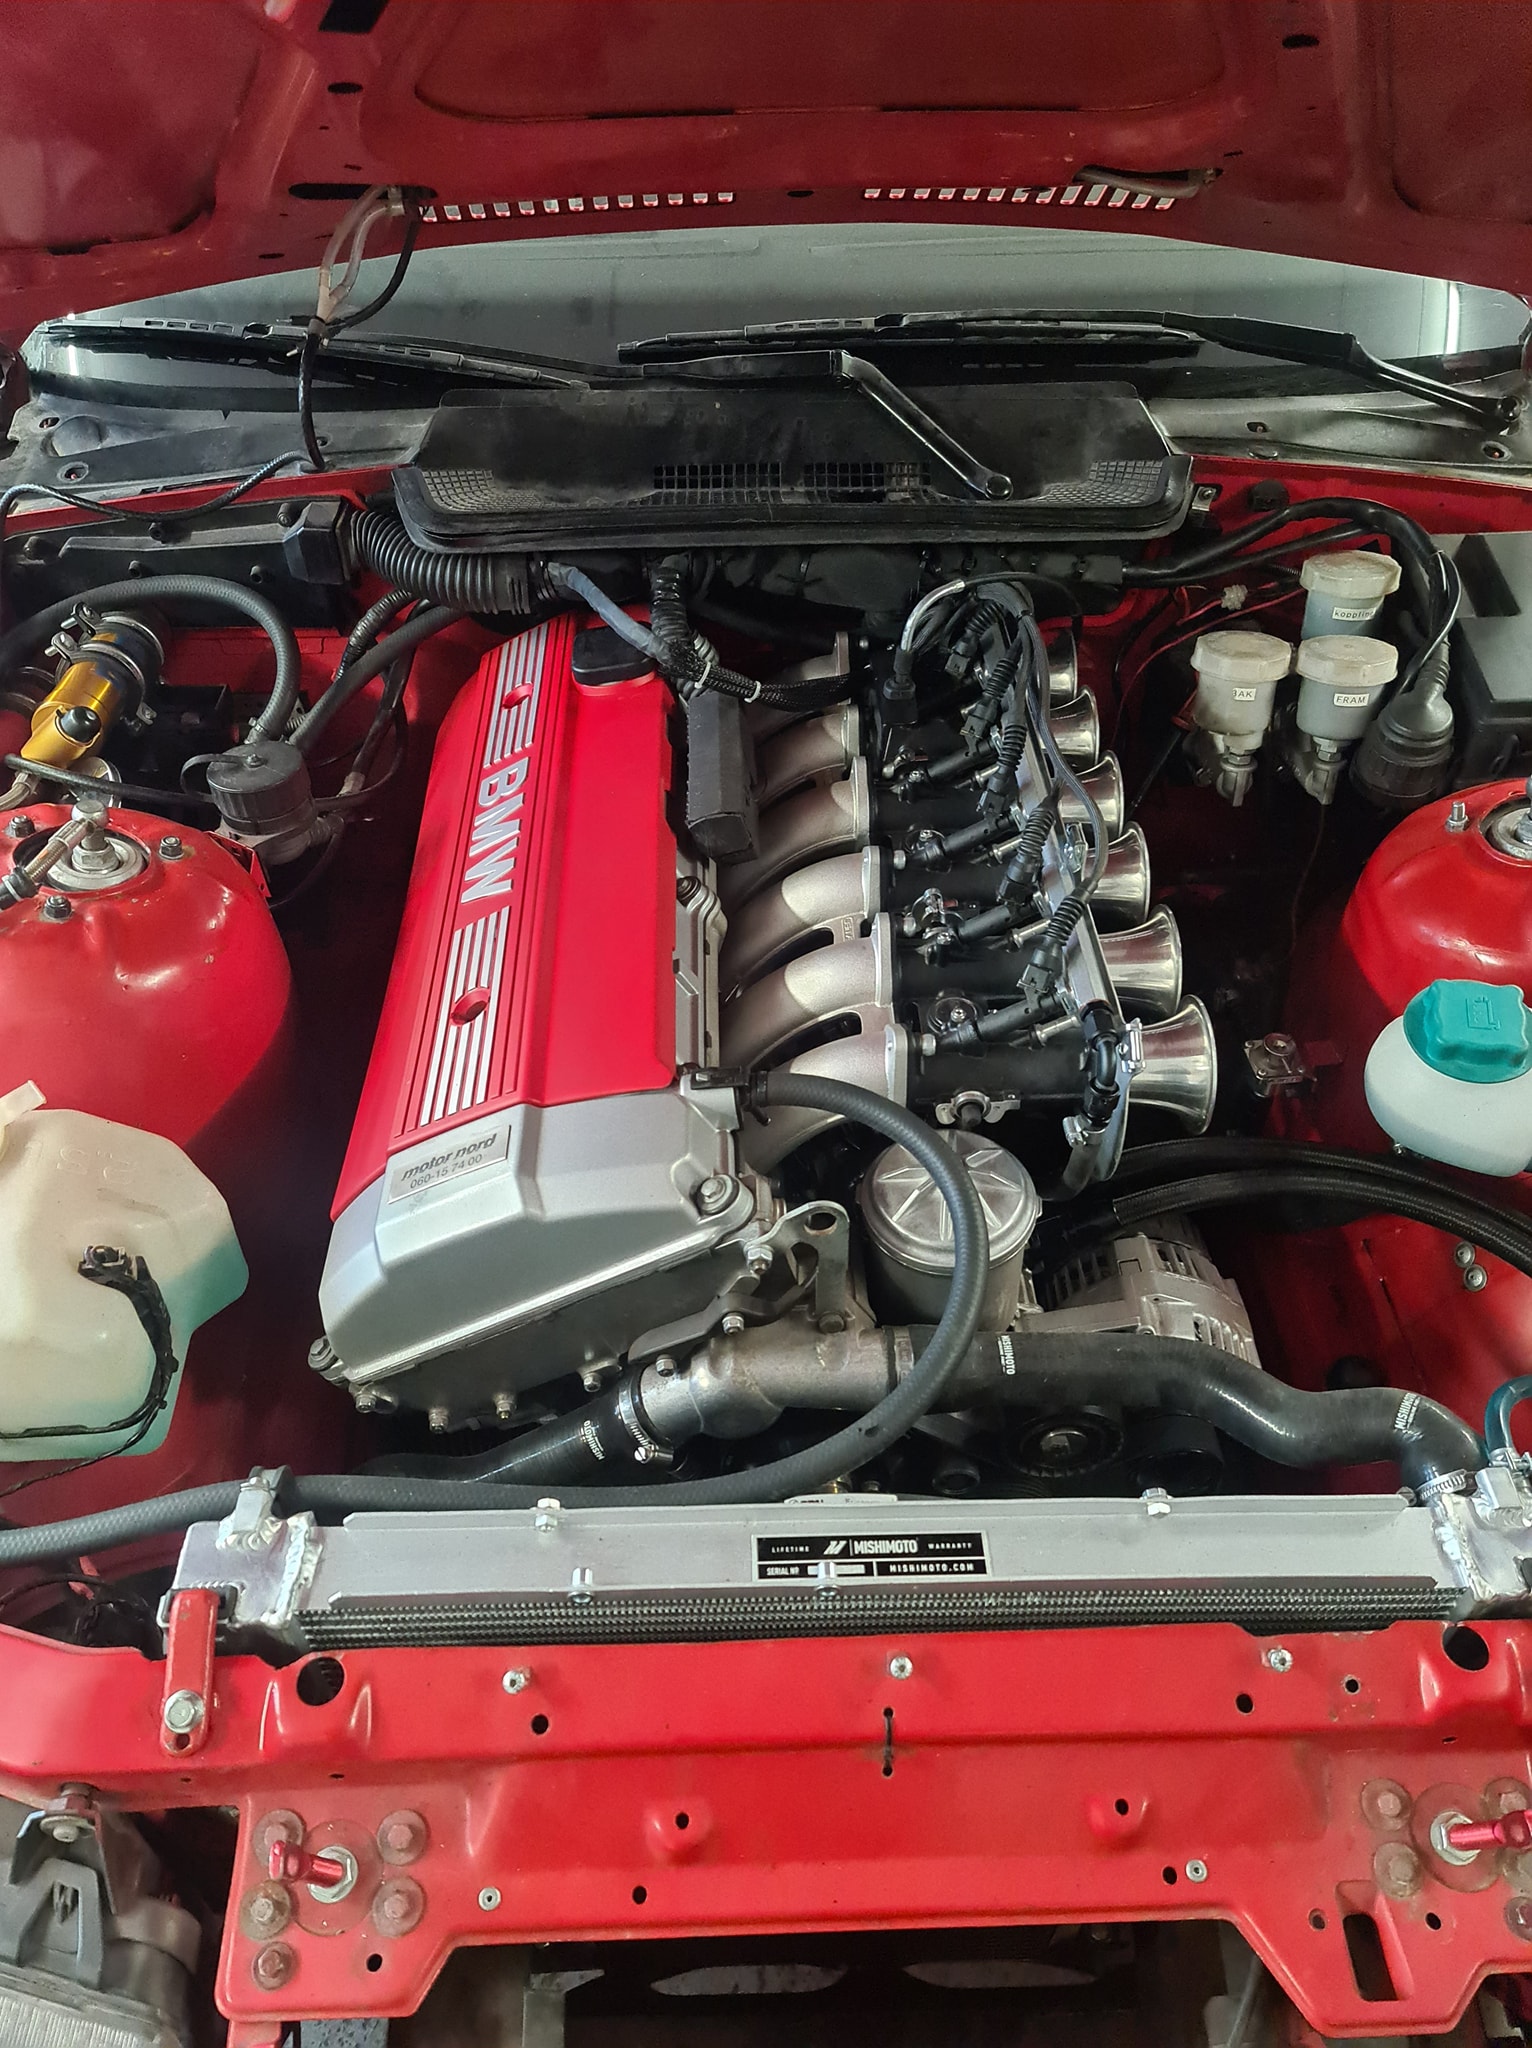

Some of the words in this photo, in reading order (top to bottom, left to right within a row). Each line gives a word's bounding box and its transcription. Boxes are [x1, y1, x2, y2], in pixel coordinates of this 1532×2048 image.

[1336, 695, 1366, 704] FRAM
[460, 756, 529, 904] BMW
[400, 1152, 453, 1182] motor
[454, 1132, 498, 1160] nord
[410, 1168, 449, 1189] 060-15
[452, 1159, 466, 1173] 74
[467, 1153, 483, 1167] 00
[583, 1420, 606, 1461] MISHIMOTO
[771, 1545, 810, 1554] LIFETIME
[853, 1539, 919, 1556] MISHIMOTO
[766, 1566, 789, 1576] SERIAL
[889, 1563, 975, 1573] MISHIMOTO.COM
